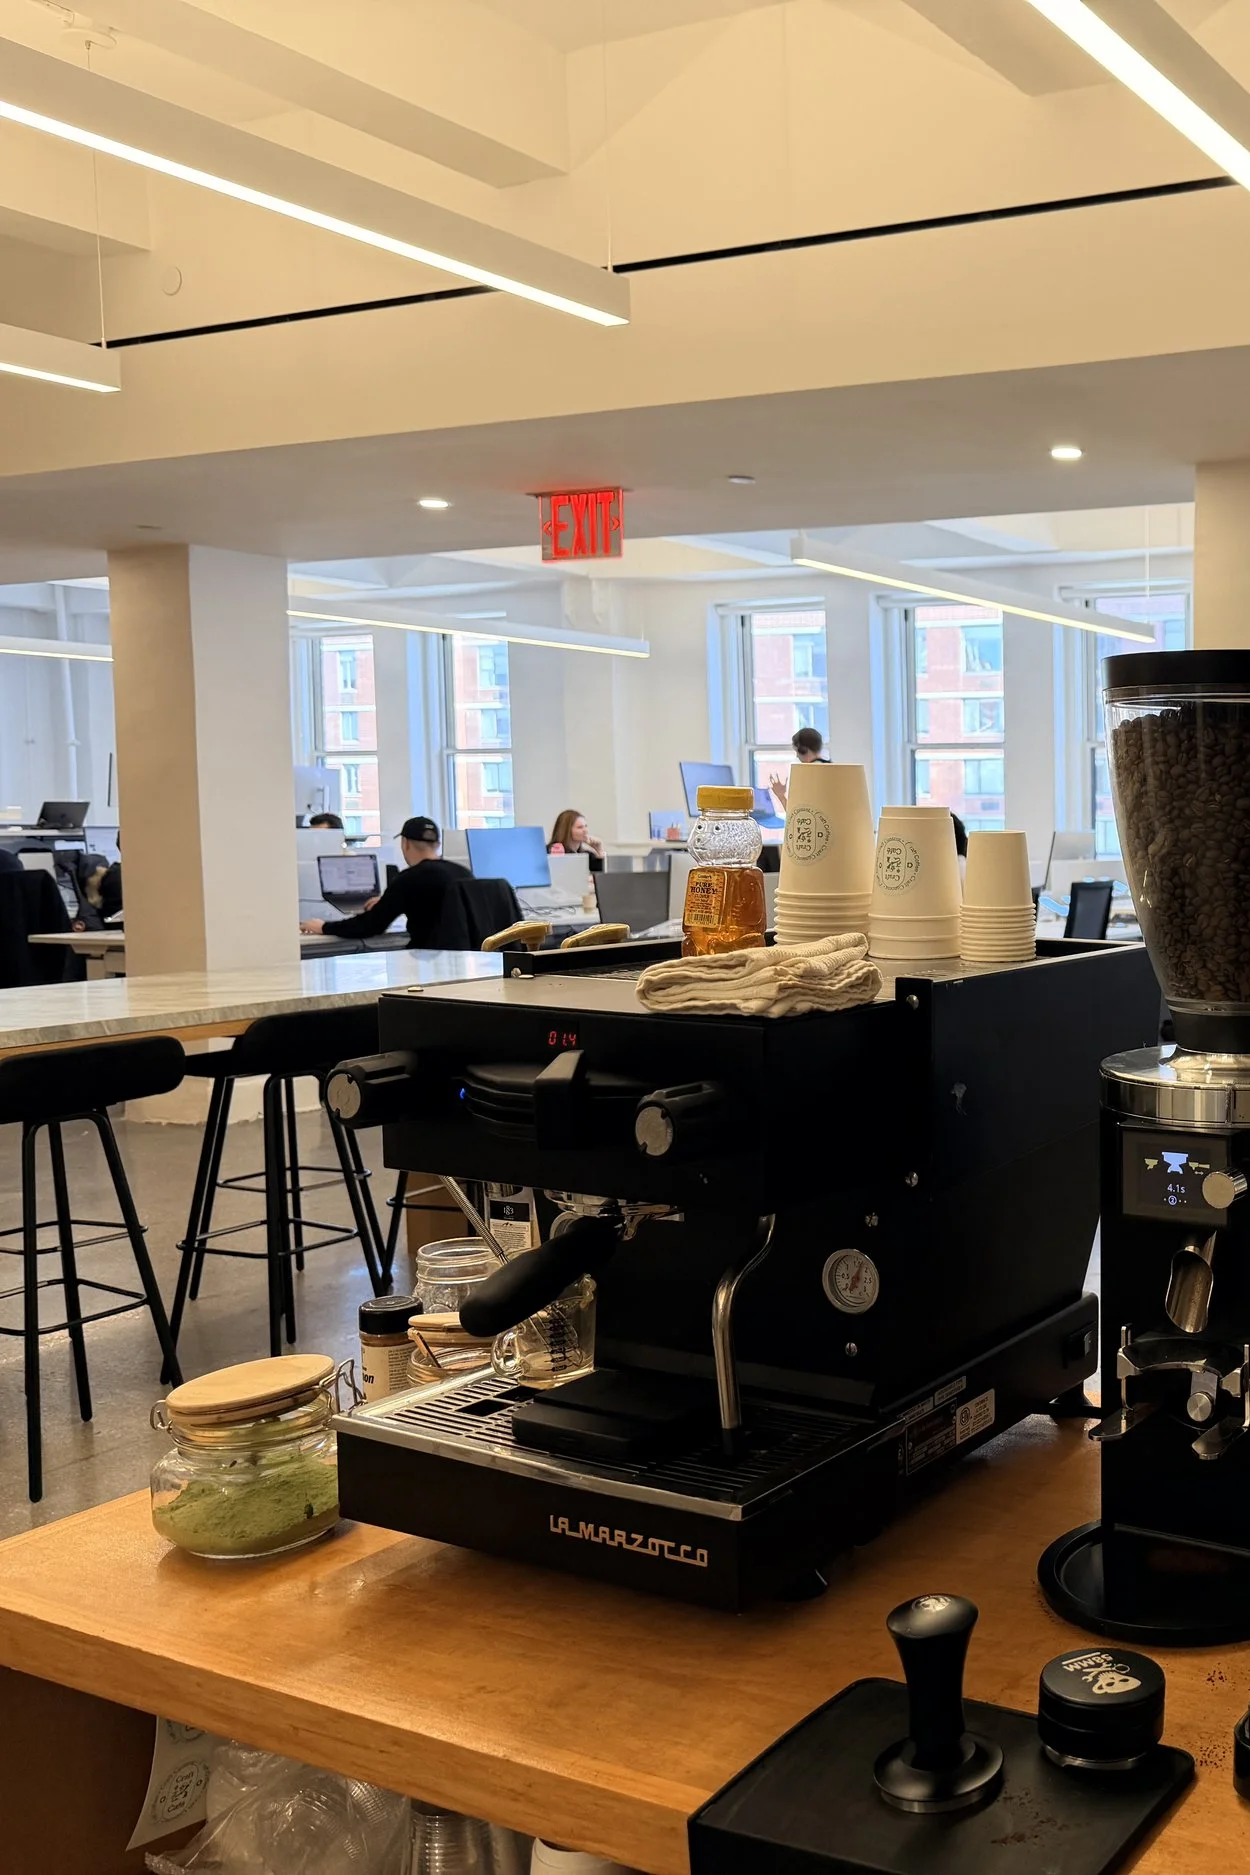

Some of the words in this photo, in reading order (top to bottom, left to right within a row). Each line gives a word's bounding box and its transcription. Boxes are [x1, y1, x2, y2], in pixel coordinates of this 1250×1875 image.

[551, 492, 615, 557] EXIT
[690, 886, 716, 894] HONEY
[1167, 1183, 1186, 1194] 4.1s
[550, 1515, 569, 1533] LA
[579, 1521, 708, 1567] MARZOCCO
[1062, 1653, 1113, 1671] 58MM
